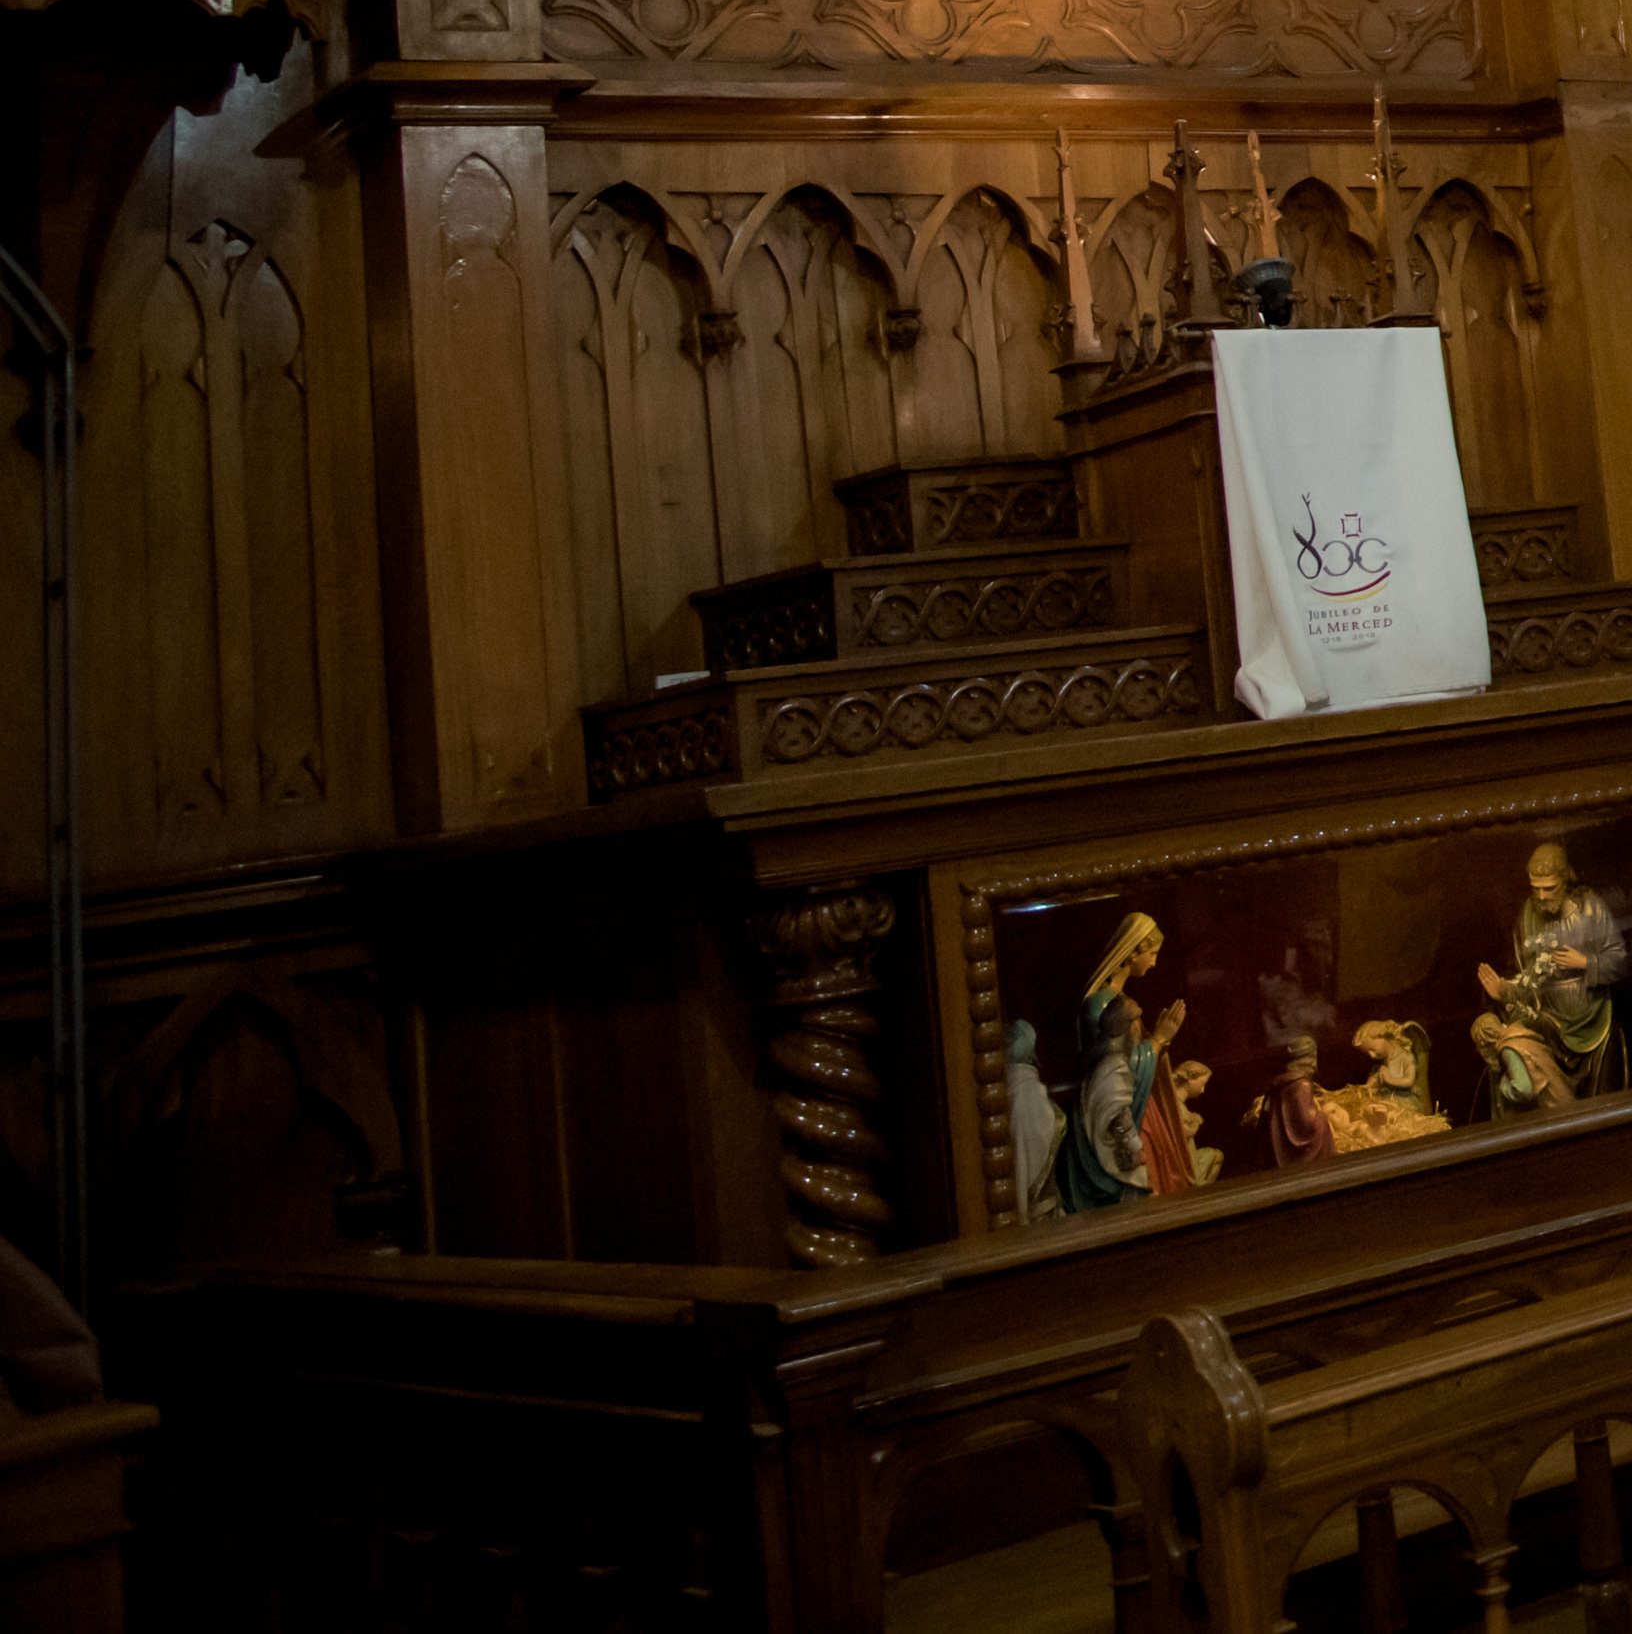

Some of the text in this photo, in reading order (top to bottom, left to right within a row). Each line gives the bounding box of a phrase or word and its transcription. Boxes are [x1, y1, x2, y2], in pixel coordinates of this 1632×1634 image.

[1308, 604, 1390, 621] JUBILEO DE
[1308, 618, 1393, 636] LA MERCED
